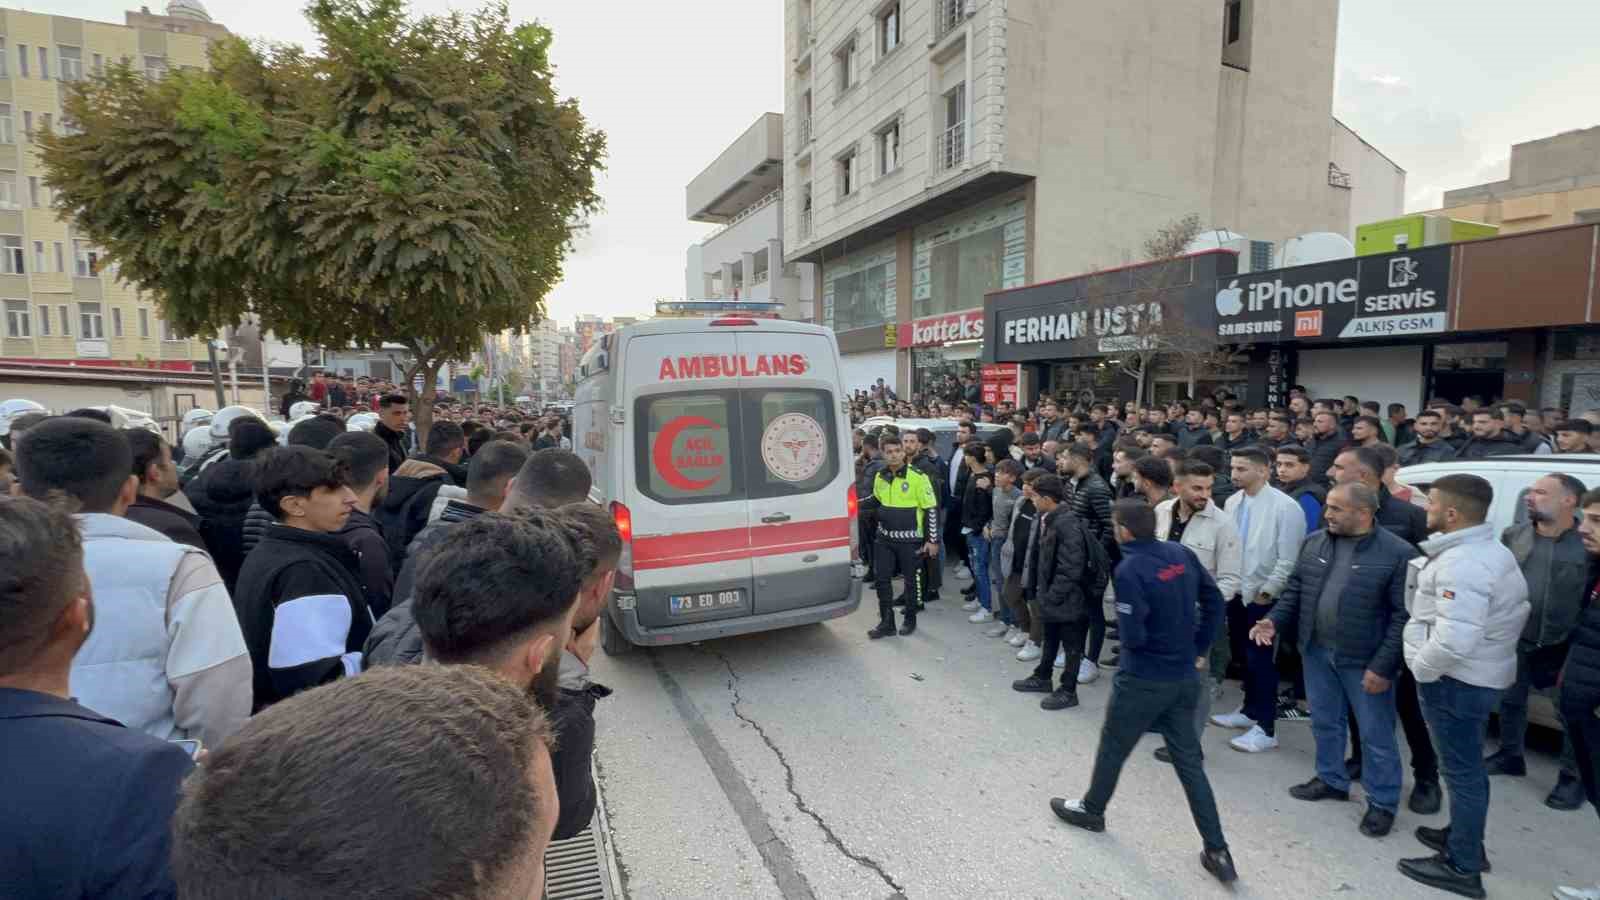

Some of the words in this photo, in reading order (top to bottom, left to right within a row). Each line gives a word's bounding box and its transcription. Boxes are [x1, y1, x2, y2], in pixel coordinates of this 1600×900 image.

[1247, 278, 1359, 311] iPhone
[1364, 288, 1437, 312] SERVİS
[1004, 311, 1088, 344] FERHAN
[1218, 320, 1283, 336] SAMSUNG
[1399, 317, 1434, 331] GSM
[658, 354, 809, 380] AMBULANS
